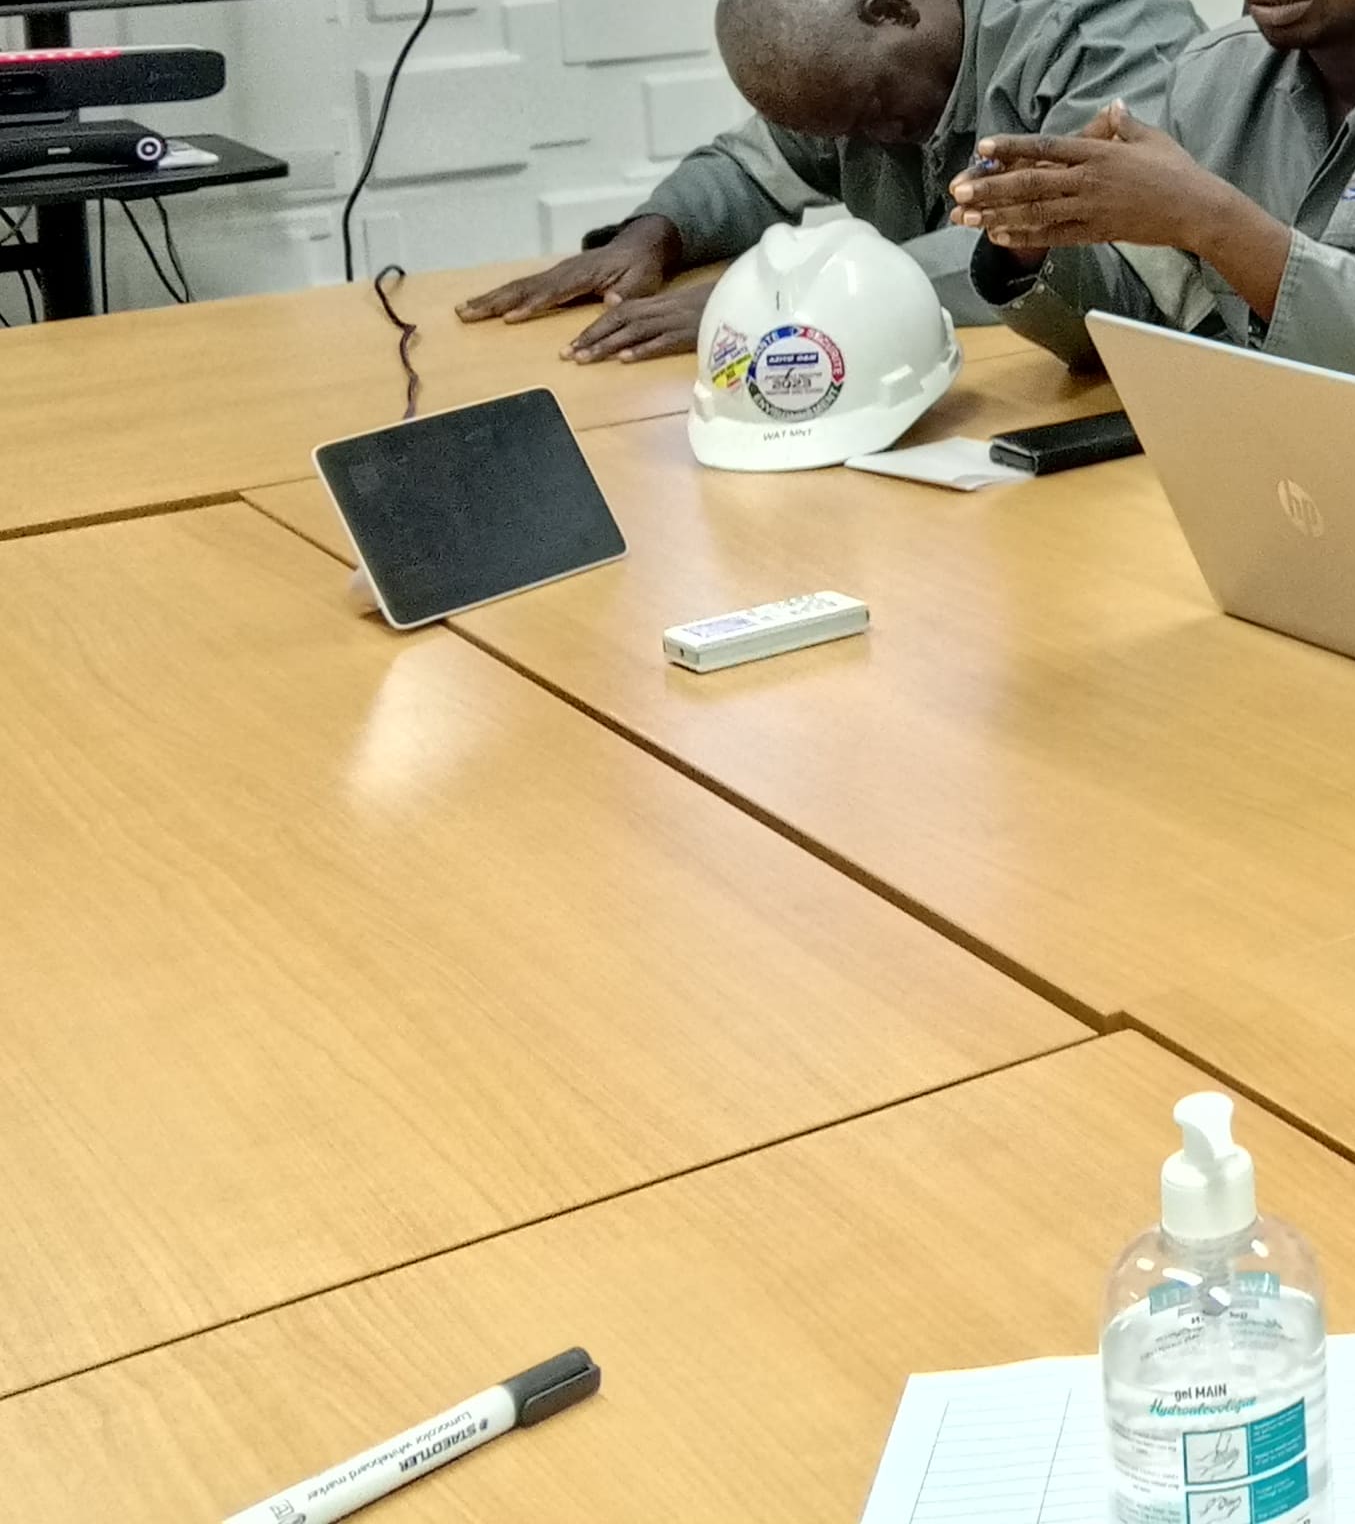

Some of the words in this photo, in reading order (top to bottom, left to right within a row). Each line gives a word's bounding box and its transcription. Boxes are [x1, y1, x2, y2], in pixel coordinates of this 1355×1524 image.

[1174, 1386, 1193, 1403] gel
[1195, 1383, 1228, 1400] MAIN
[399, 1422, 478, 1473] STAEDTLER
[306, 1476, 348, 1501] marker
